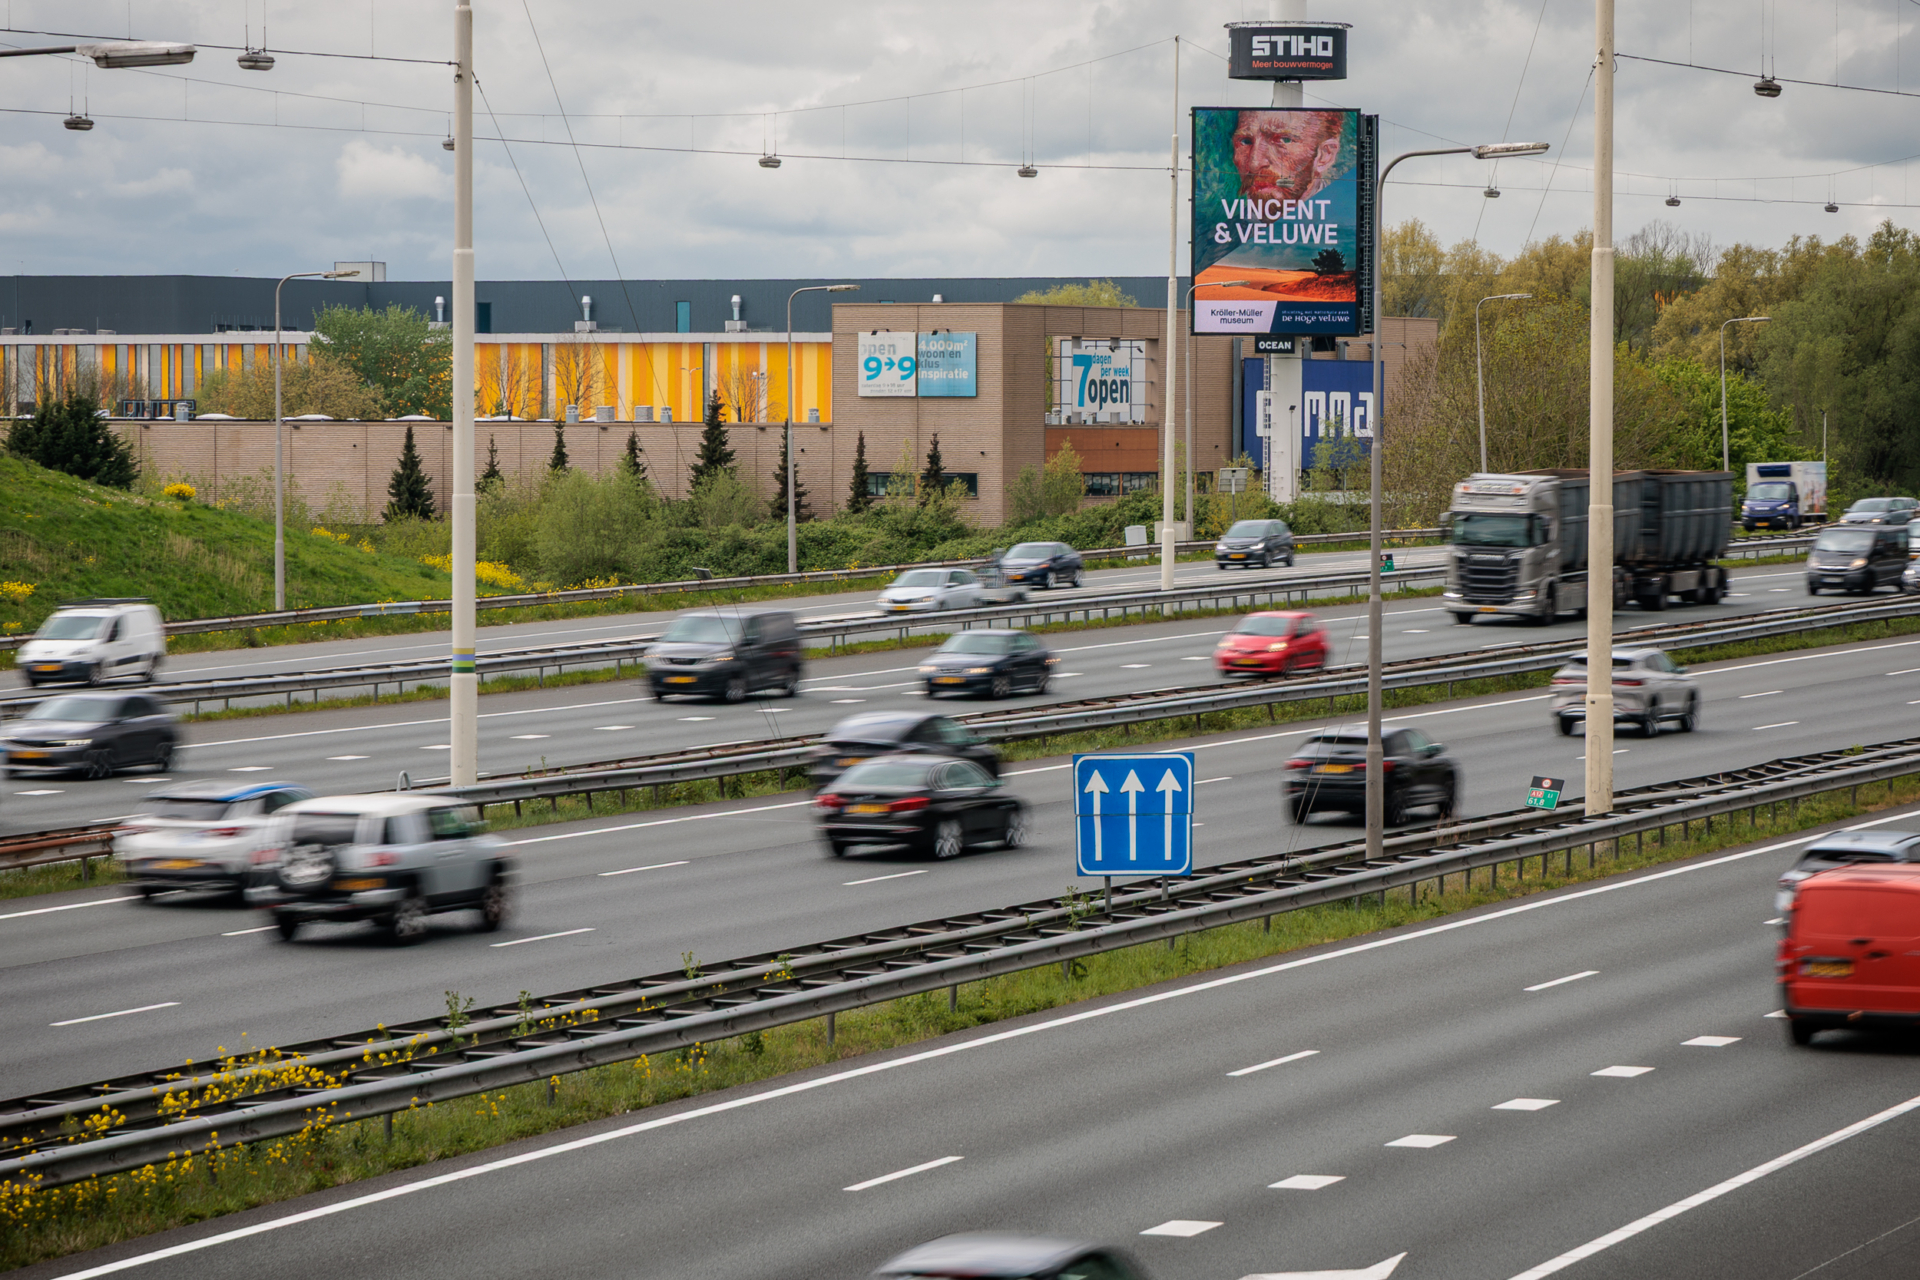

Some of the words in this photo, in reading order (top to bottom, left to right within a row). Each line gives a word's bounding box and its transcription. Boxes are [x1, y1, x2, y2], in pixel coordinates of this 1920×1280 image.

[1252, 35, 1333, 57] STIHO
[1252, 60, 1272, 68] Meer
[1273, 60, 1333, 70] bouwvermogen
[1221, 198, 1331, 220] VINCENT
[1214, 222, 1232, 244] &
[1236, 223, 1338, 244] VELUWE
[1210, 308, 1263, 317] Kröller-Müller
[1220, 317, 1254, 325] museum
[1258, 340, 1292, 350] OCEAN
[918, 358, 940, 368] klus
[918, 368, 969, 380] inspiratie
[1100, 367, 1112, 378] per
[1113, 365, 1129, 377] week
[1073, 354, 1093, 407] 7
[1092, 352, 1112, 366] dagen
[1088, 378, 1129, 412] open
